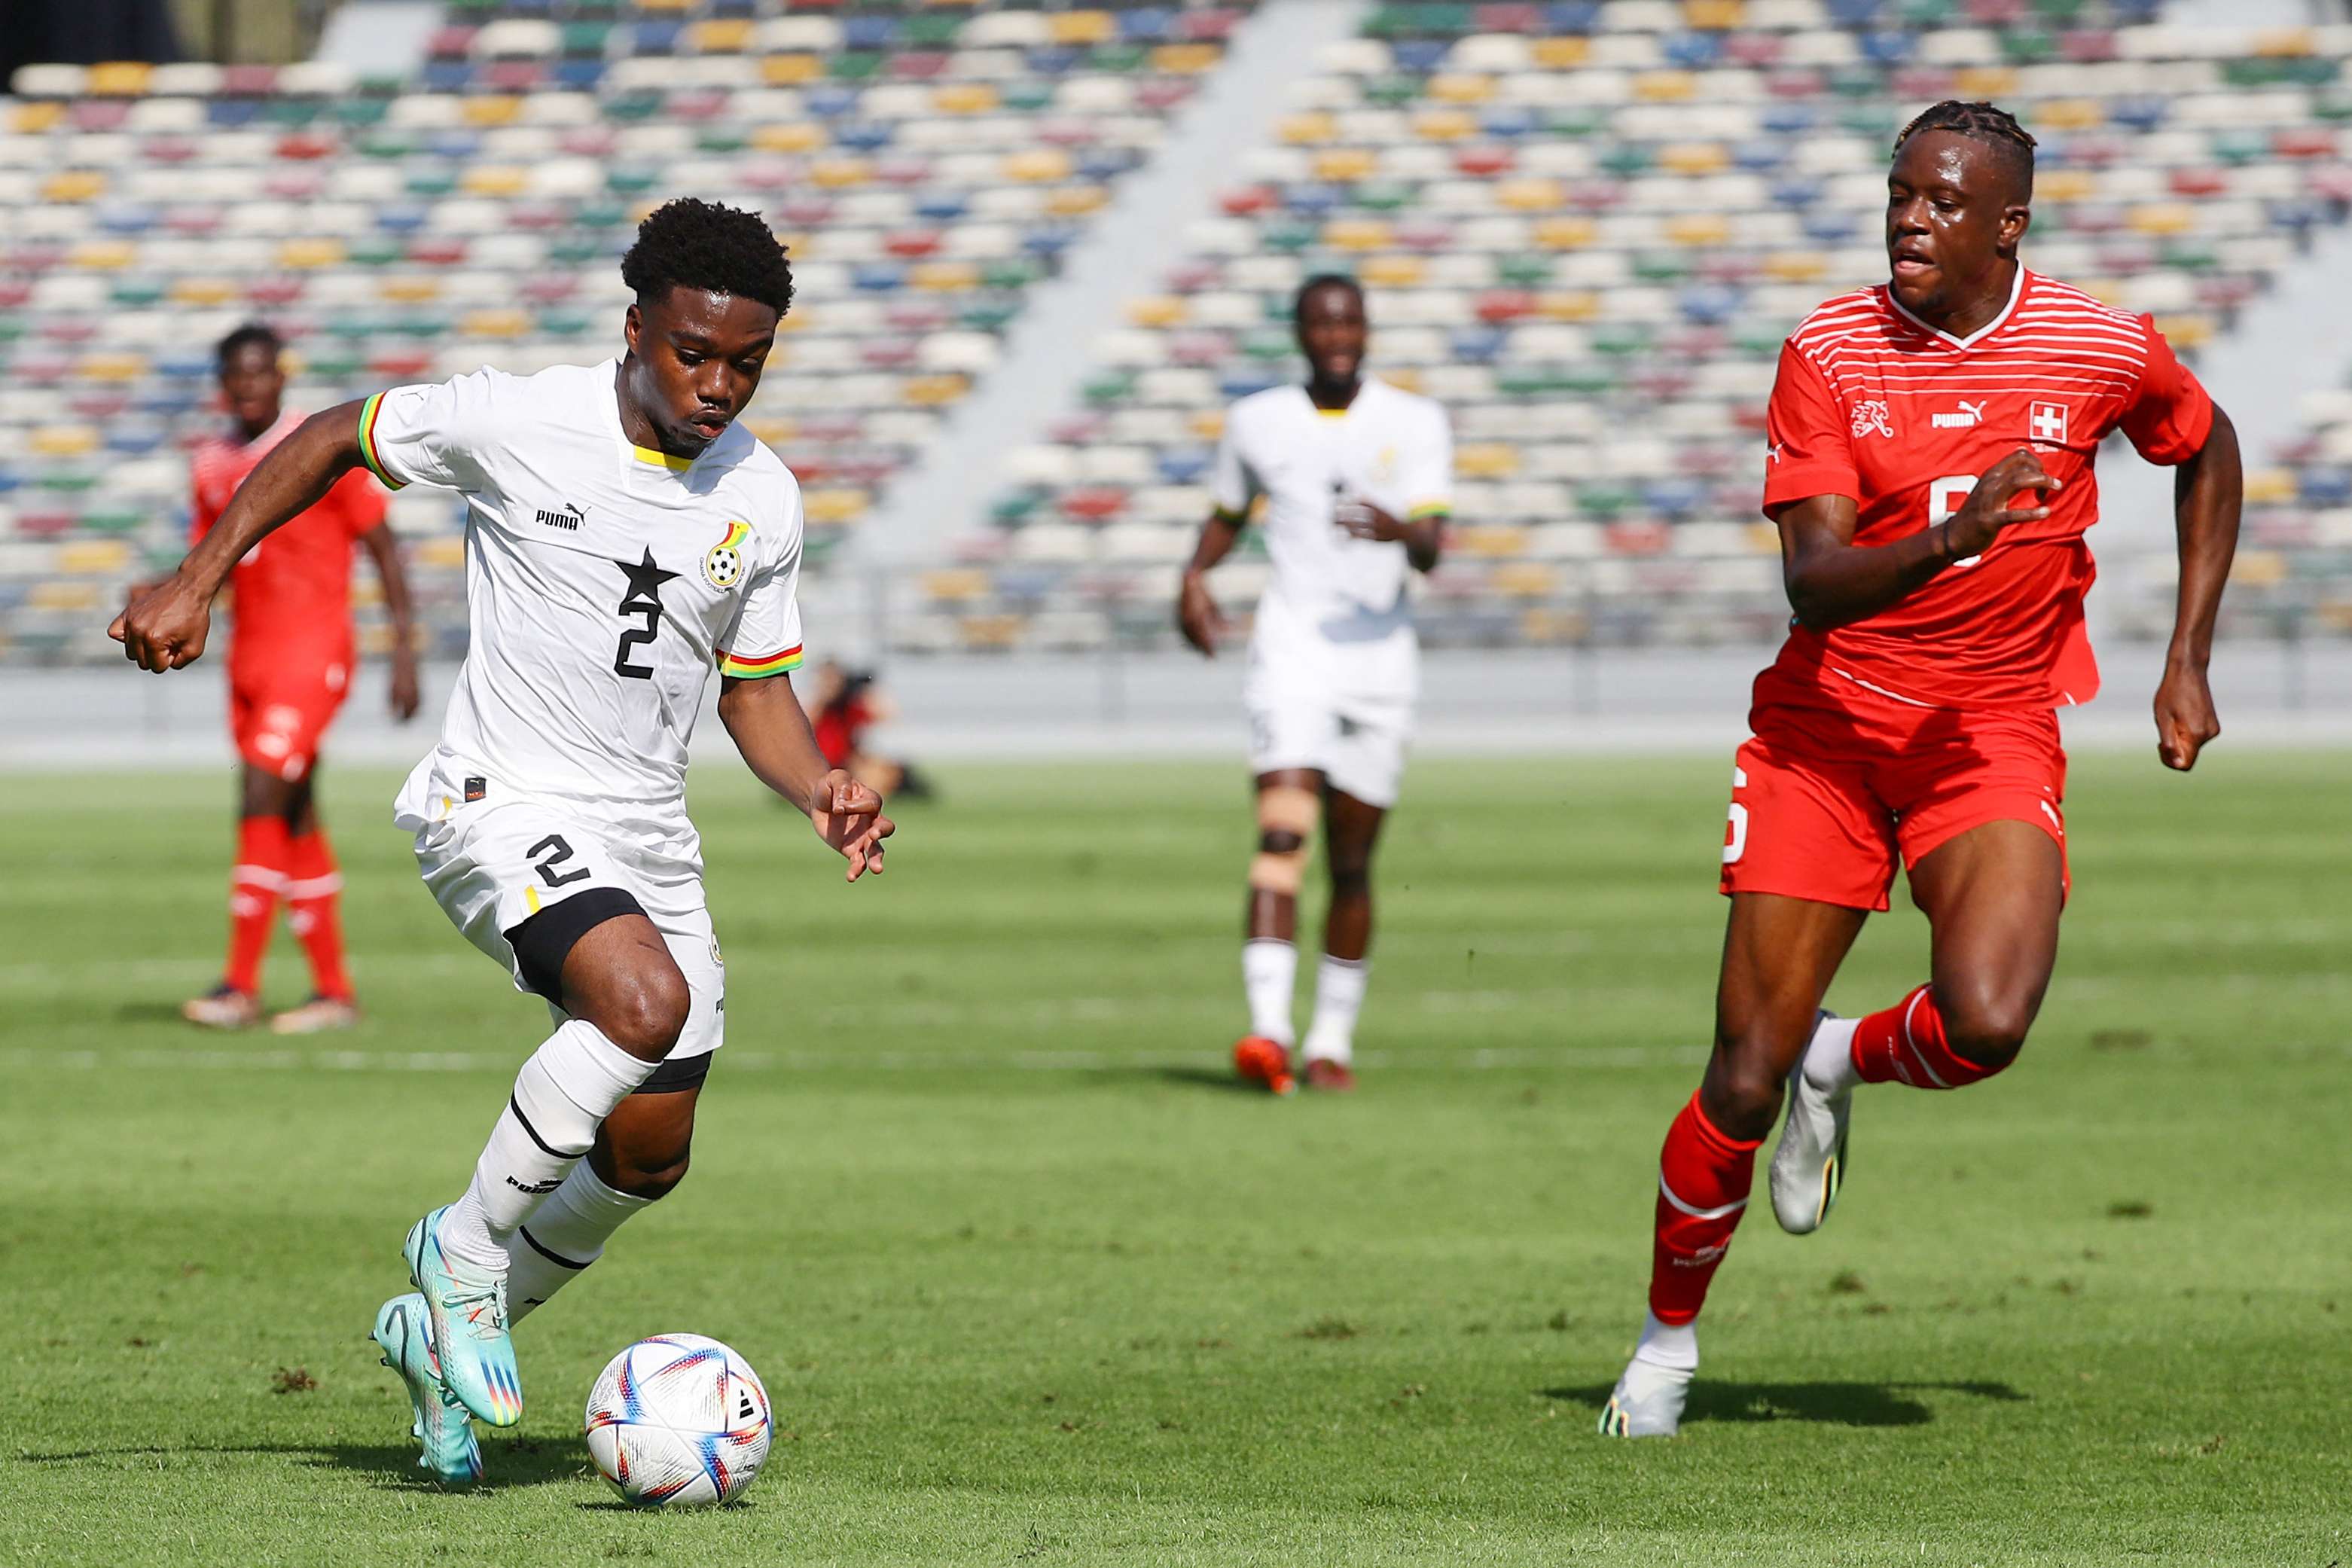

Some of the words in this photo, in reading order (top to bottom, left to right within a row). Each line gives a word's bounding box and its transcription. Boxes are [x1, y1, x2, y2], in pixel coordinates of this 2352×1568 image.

[1932, 413, 1975, 429] PUMA
[535, 509, 578, 530] PUMA
[614, 601, 658, 680] 2
[526, 834, 591, 888] 2
